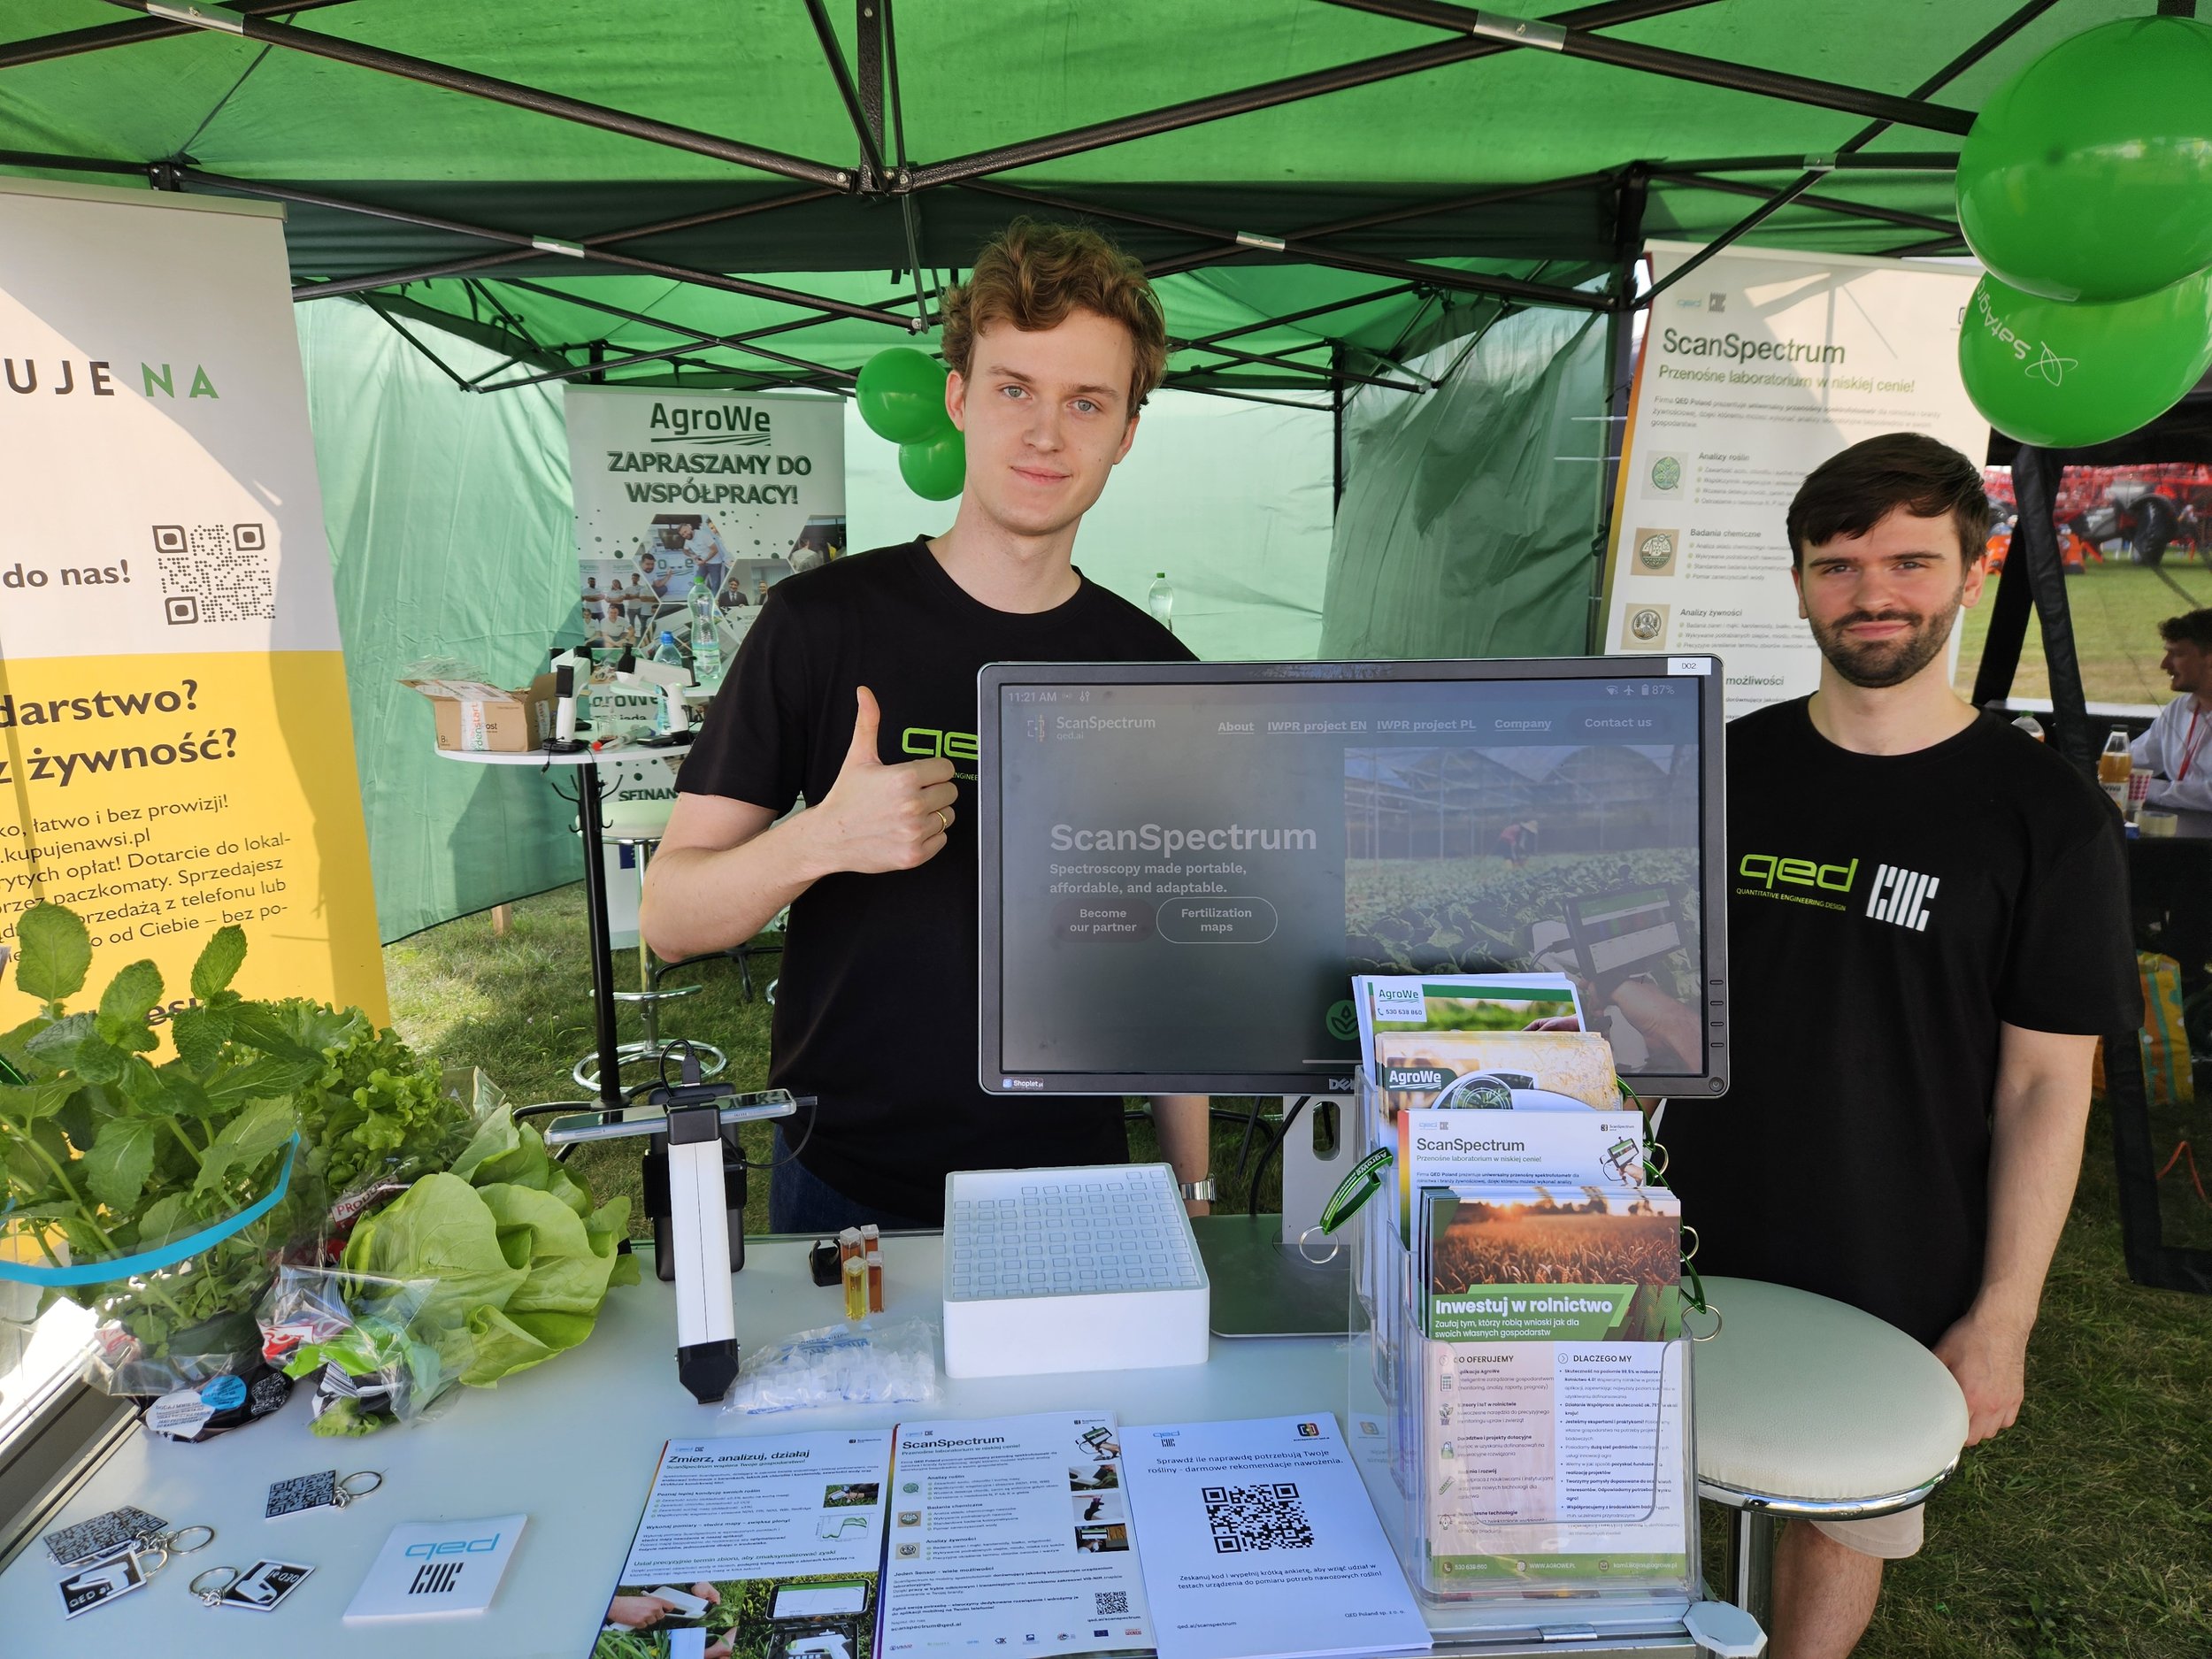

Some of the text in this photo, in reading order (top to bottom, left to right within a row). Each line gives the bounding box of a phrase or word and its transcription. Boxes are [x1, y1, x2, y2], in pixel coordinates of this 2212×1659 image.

[1663, 327, 1846, 364] ScanSpectrum
[4, 358, 219, 398] UJE NA
[1658, 365, 1915, 394] Przenośne laboratorium w niskiej cenie!
[649, 403, 771, 435] AgroWe
[607, 451, 811, 476] ZAPRASZAMY DO
[1698, 452, 1750, 463] Analizy roślin
[624, 477, 800, 505] WSPÓŁPRACY!
[1690, 528, 1761, 539] Badania chemiczne
[3, 559, 131, 588] do nas!
[1680, 609, 1742, 618] Analizy żywności
[1725, 675, 1784, 686] możliwości
[1009, 692, 1057, 702] 11:21 AM
[1652, 685, 1675, 695] 87%
[0, 679, 198, 728] darstwo?
[1056, 716, 1156, 731] ScanSpectrum
[1217, 718, 1652, 734] About IWPR project EN IWPR project PL Company Contact us
[1056, 731, 1084, 741] qed.ai
[27, 727, 237, 787] żywność?
[34, 816, 90, 833] łatwo
[96, 810, 102, 824] i
[107, 808, 142, 824] bez
[149, 794, 228, 822] prowizji!
[1050, 824, 1317, 858] ScanSpectrum
[66, 856, 121, 880] opłat!
[127, 846, 210, 869] Dotarcie
[216, 841, 239, 856] do
[244, 832, 291, 852] lokal-
[1049, 864, 1247, 876] Spectroscopy made portable,
[1740, 854, 1859, 892] qed
[54, 876, 173, 905] paczkomaty.
[178, 858, 283, 887] Sprzedajesz
[1049, 881, 1227, 895] affordable, and adaptable.
[165, 899, 176, 910] z
[181, 887, 256, 907] telefonu
[261, 879, 287, 894] lub
[1736, 888, 1847, 911] QUANTITATIVE ENGINEERING DESIGN
[1079, 909, 1127, 918] Become
[1181, 908, 1252, 918] Fertilization
[110, 926, 134, 943] od
[140, 918, 200, 938] Ciebie
[222, 910, 254, 924] bez
[260, 905, 288, 920] po-
[1093, 923, 1137, 934] partner
[1201, 923, 1233, 933] maps
[1379, 989, 1418, 1000] AgroWe
[1389, 1070, 1441, 1086] AgroWe
[1417, 1138, 1525, 1153] ScanSpectrum
[1435, 1297, 1612, 1317] Inwestuj w rolnictwo
[1435, 1319, 1459, 1328] Zaufaj
[1460, 1319, 1477, 1328] tym,
[1479, 1318, 1501, 1327] którzy
[1463, 1329, 1499, 1339] własnych
[1500, 1329, 1550, 1339] gospodarstw
[902, 1436, 1005, 1449] ScanSpectrum
[668, 1449, 810, 1463] Zmierz, analizuj, działaj
[1209, 1454, 1253, 1463] naprawdę
[1254, 1451, 1302, 1461] potrzebują
[1185, 1463, 1227, 1472] darmowe
[1229, 1461, 1292, 1471] rekomendacje
[1294, 1458, 1344, 1467] nawożenia.
[404, 1532, 500, 1562] qed
[1230, 1571, 1259, 1579] wypełnij
[1255, 1577, 1285, 1586] pomiaru
[1314, 1571, 1359, 1581] nawozowych
